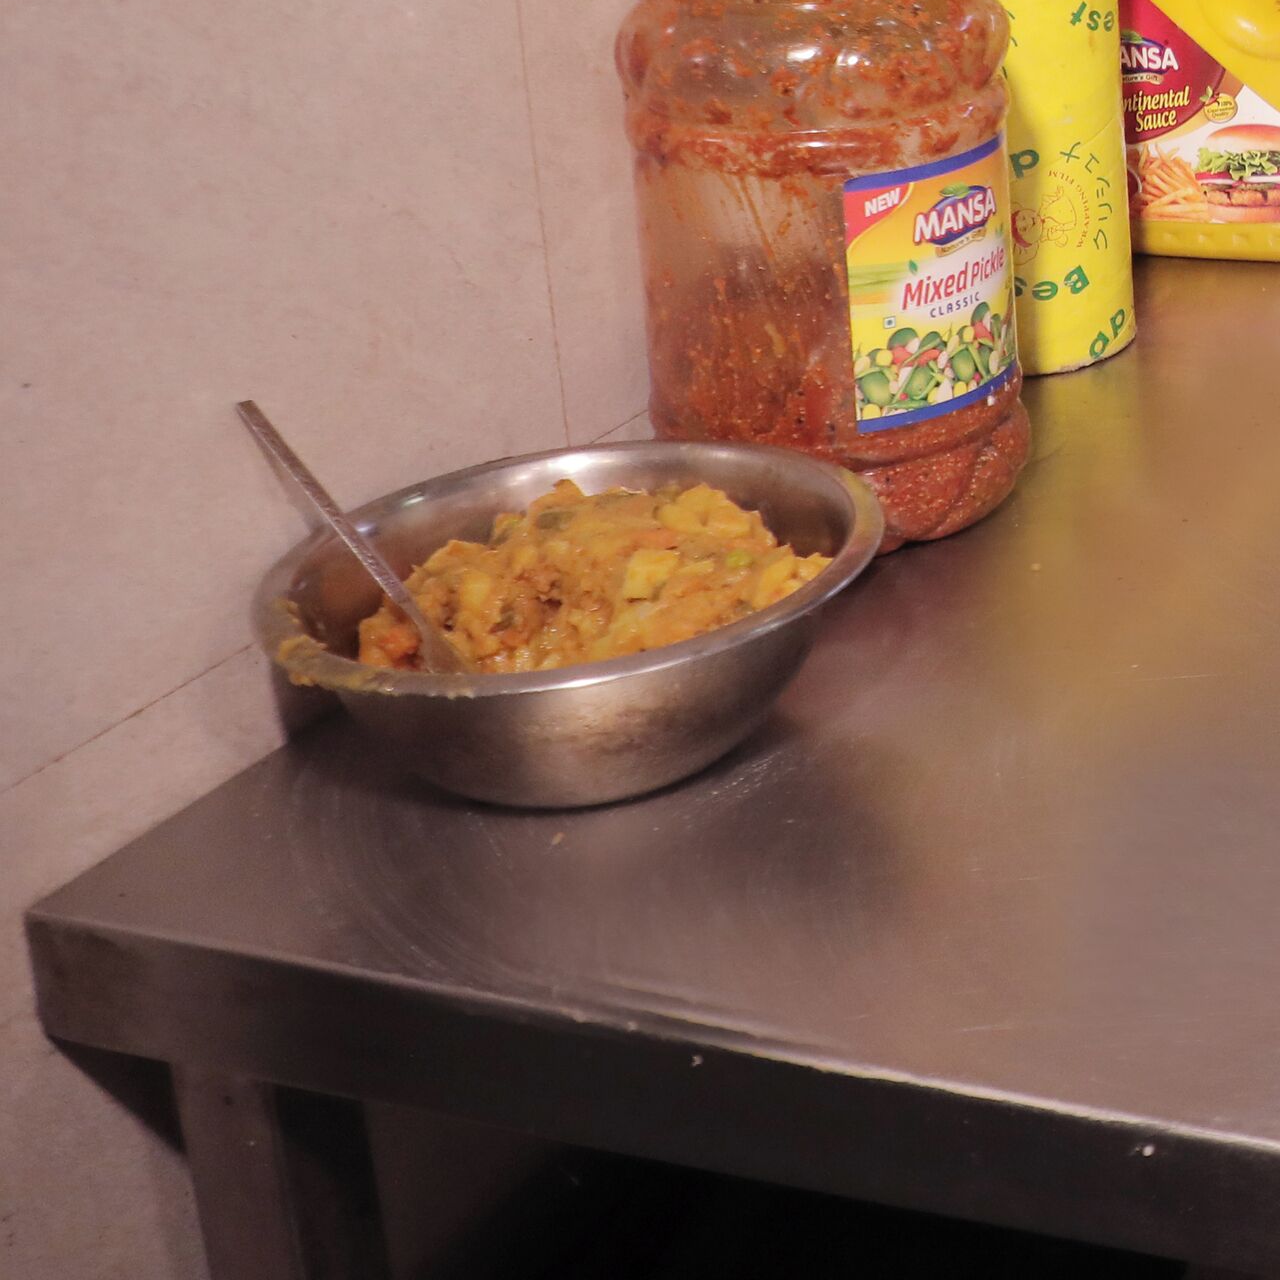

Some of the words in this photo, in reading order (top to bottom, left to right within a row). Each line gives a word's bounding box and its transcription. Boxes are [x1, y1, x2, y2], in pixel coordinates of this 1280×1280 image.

[1070, 1, 1115, 32] est
[1120, 45, 1179, 71] ANSA
[1123, 85, 1190, 113] ntinental
[1135, 110, 1177, 132] Sauce
[864, 188, 901, 218] NEW
[913, 186, 997, 244] MANSA
[902, 261, 968, 312] Mixed
[971, 246, 1004, 288] Pickle
[930, 291, 981, 318] CLASSIC
[1089, 308, 1126, 359] ap
